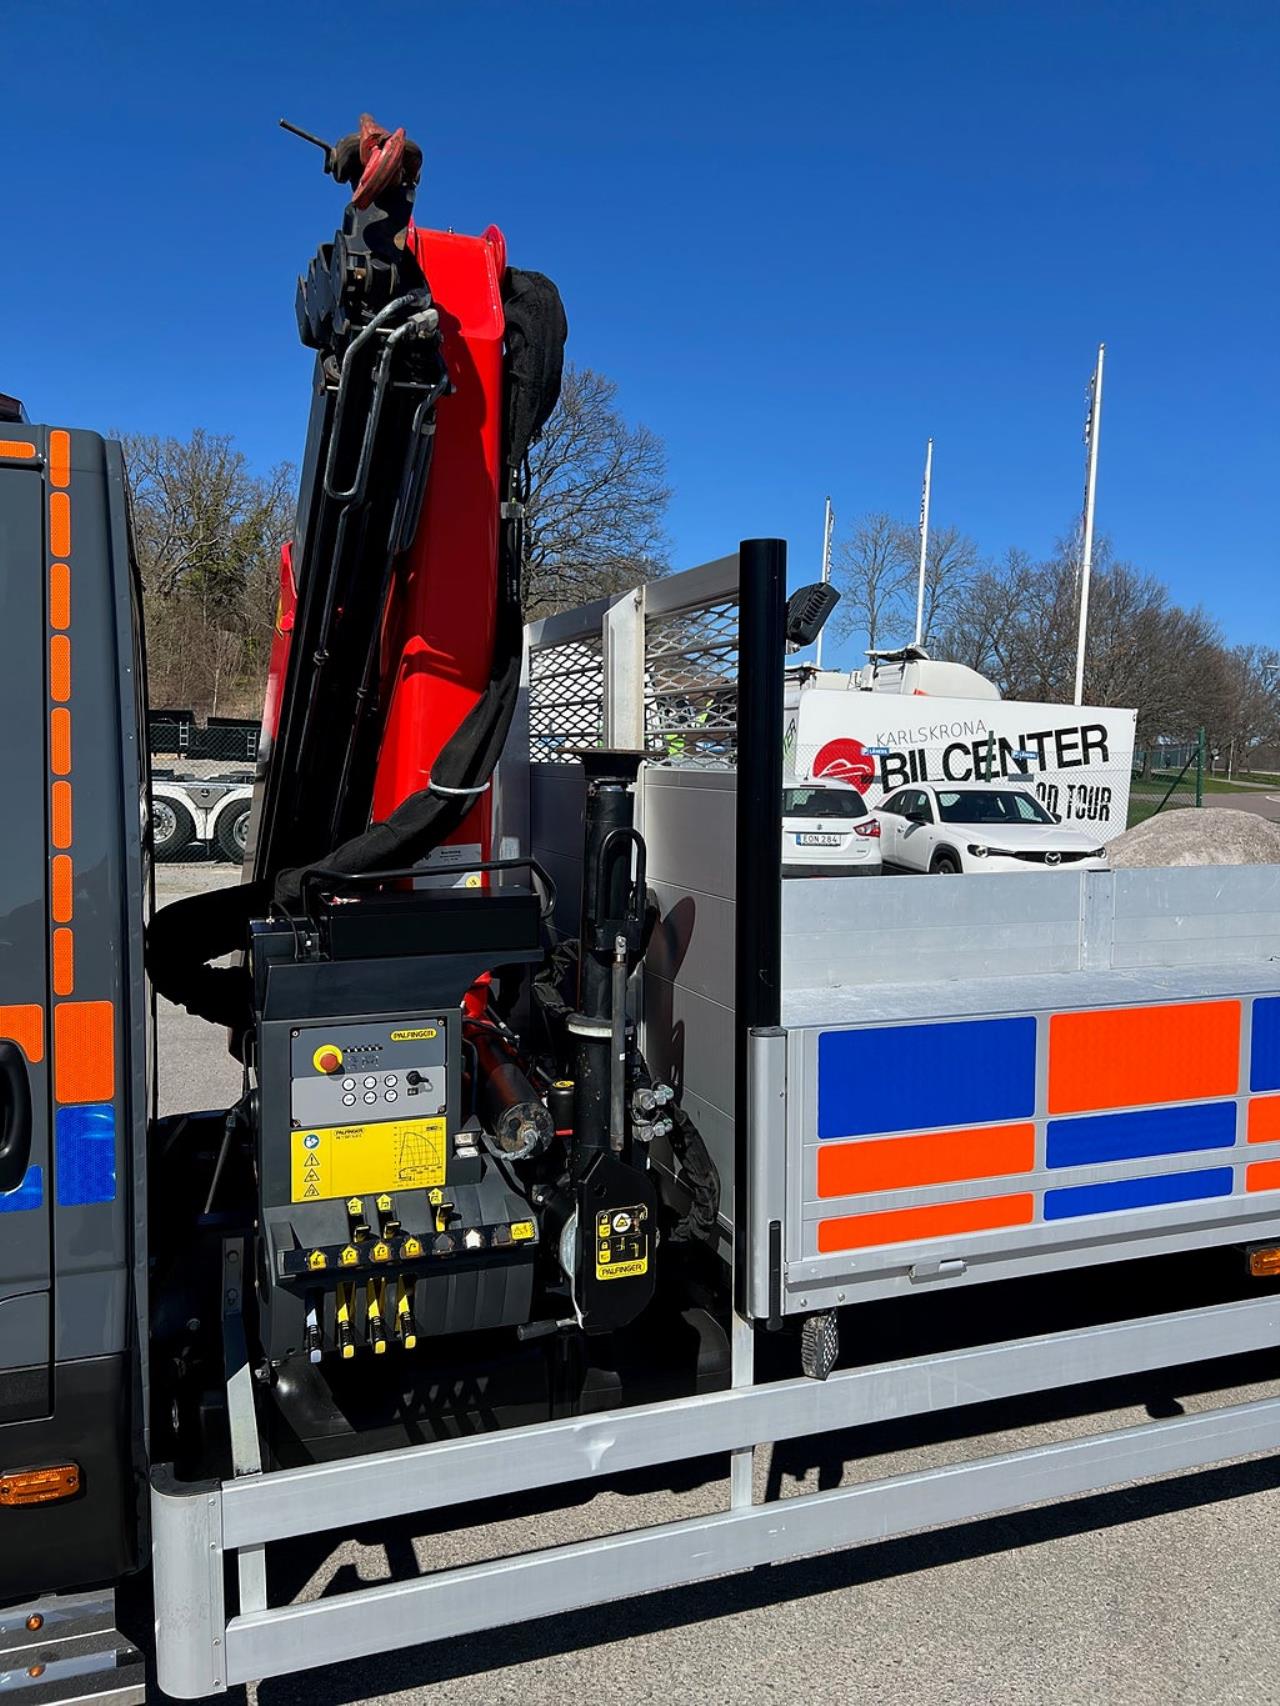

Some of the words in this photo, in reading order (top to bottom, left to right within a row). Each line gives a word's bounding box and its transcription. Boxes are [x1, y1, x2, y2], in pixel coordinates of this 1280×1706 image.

[876, 719, 987, 747] KARLSKRONA
[880, 724, 1109, 793] BILCENTER
[1066, 784, 1112, 821] TOUR
[821, 835, 837, 843] 284
[393, 1030, 434, 1039] PALFINGER
[601, 1264, 642, 1276] PALFINGER
